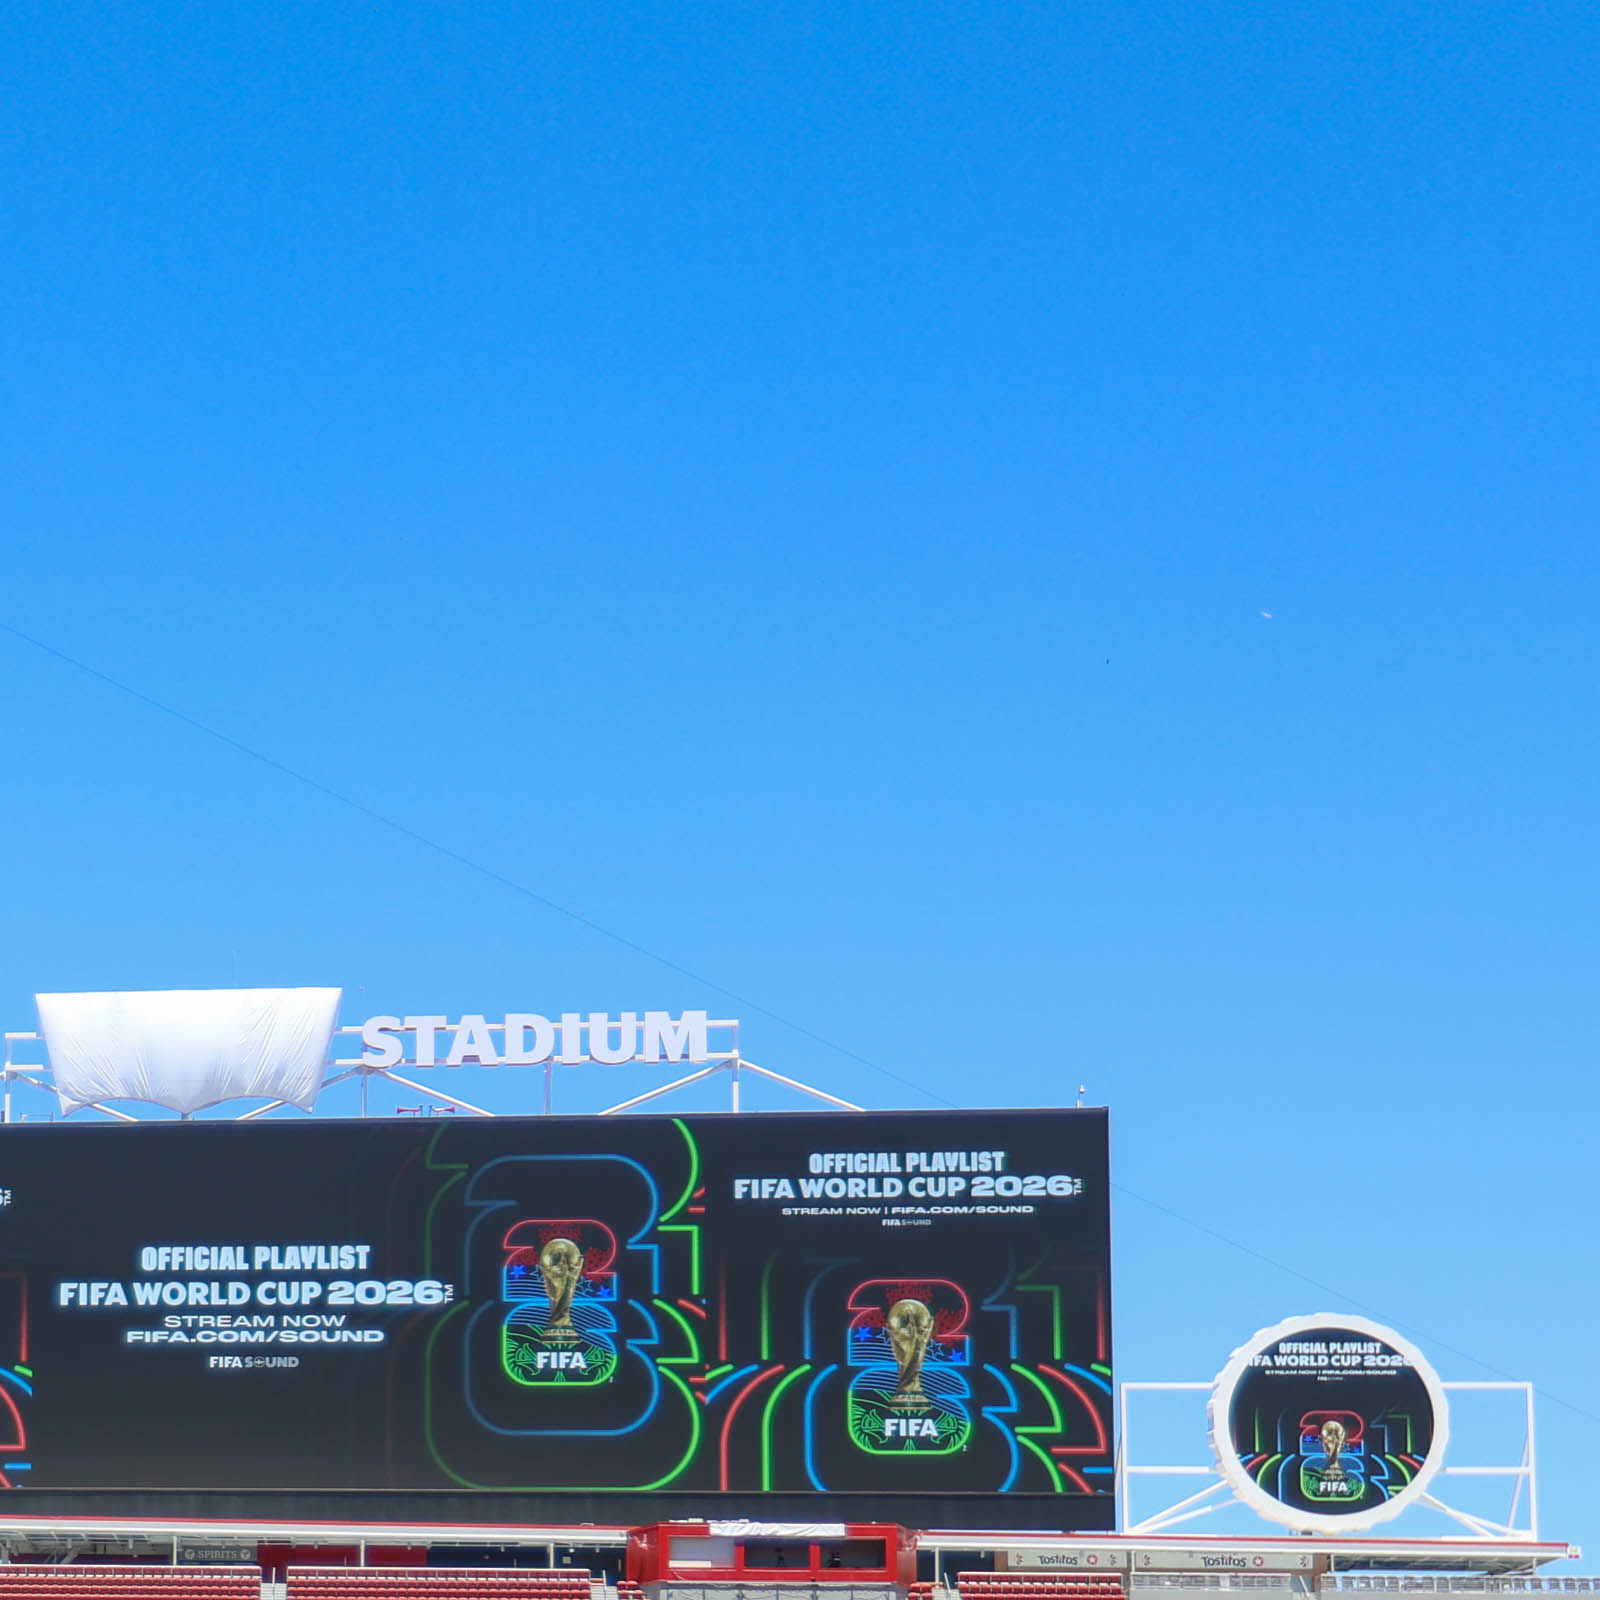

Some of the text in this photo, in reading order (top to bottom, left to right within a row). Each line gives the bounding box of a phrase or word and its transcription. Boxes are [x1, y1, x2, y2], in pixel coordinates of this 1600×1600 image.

[362, 1010, 707, 1069] STADIUM
[809, 1151, 1005, 1173] OFFICIAL PLAYLIST
[734, 1179, 795, 1199] FIFA
[799, 1178, 901, 1199] WORLD
[907, 1177, 966, 1198] CUP
[782, 1205, 1034, 1215] STREAM NOW FIFA.COM/SOUND
[142, 1245, 370, 1271] OFFICIAL PLAYLIST
[59, 1282, 128, 1306] FIFA
[133, 1281, 250, 1306] WORLD
[257, 1281, 321, 1305] CUP
[164, 1315, 346, 1327] STREAM NOW
[126, 1330, 385, 1343] FIFA.COM/SOUND
[1279, 1342, 1381, 1354] OFFICIAL PLAYLIST
[210, 1356, 242, 1368] FIFA
[536, 1352, 587, 1369] FIFA
[1274, 1355, 1328, 1367] WORLD
[1331, 1355, 1361, 1366] CUP
[884, 1418, 938, 1436] FIFA
[1319, 1481, 1348, 1492] FIFA
[198, 1549, 237, 1559] SPIRITS
[1038, 1555, 1078, 1566] Tostitos
[1200, 1554, 1246, 1567] Tostitos
